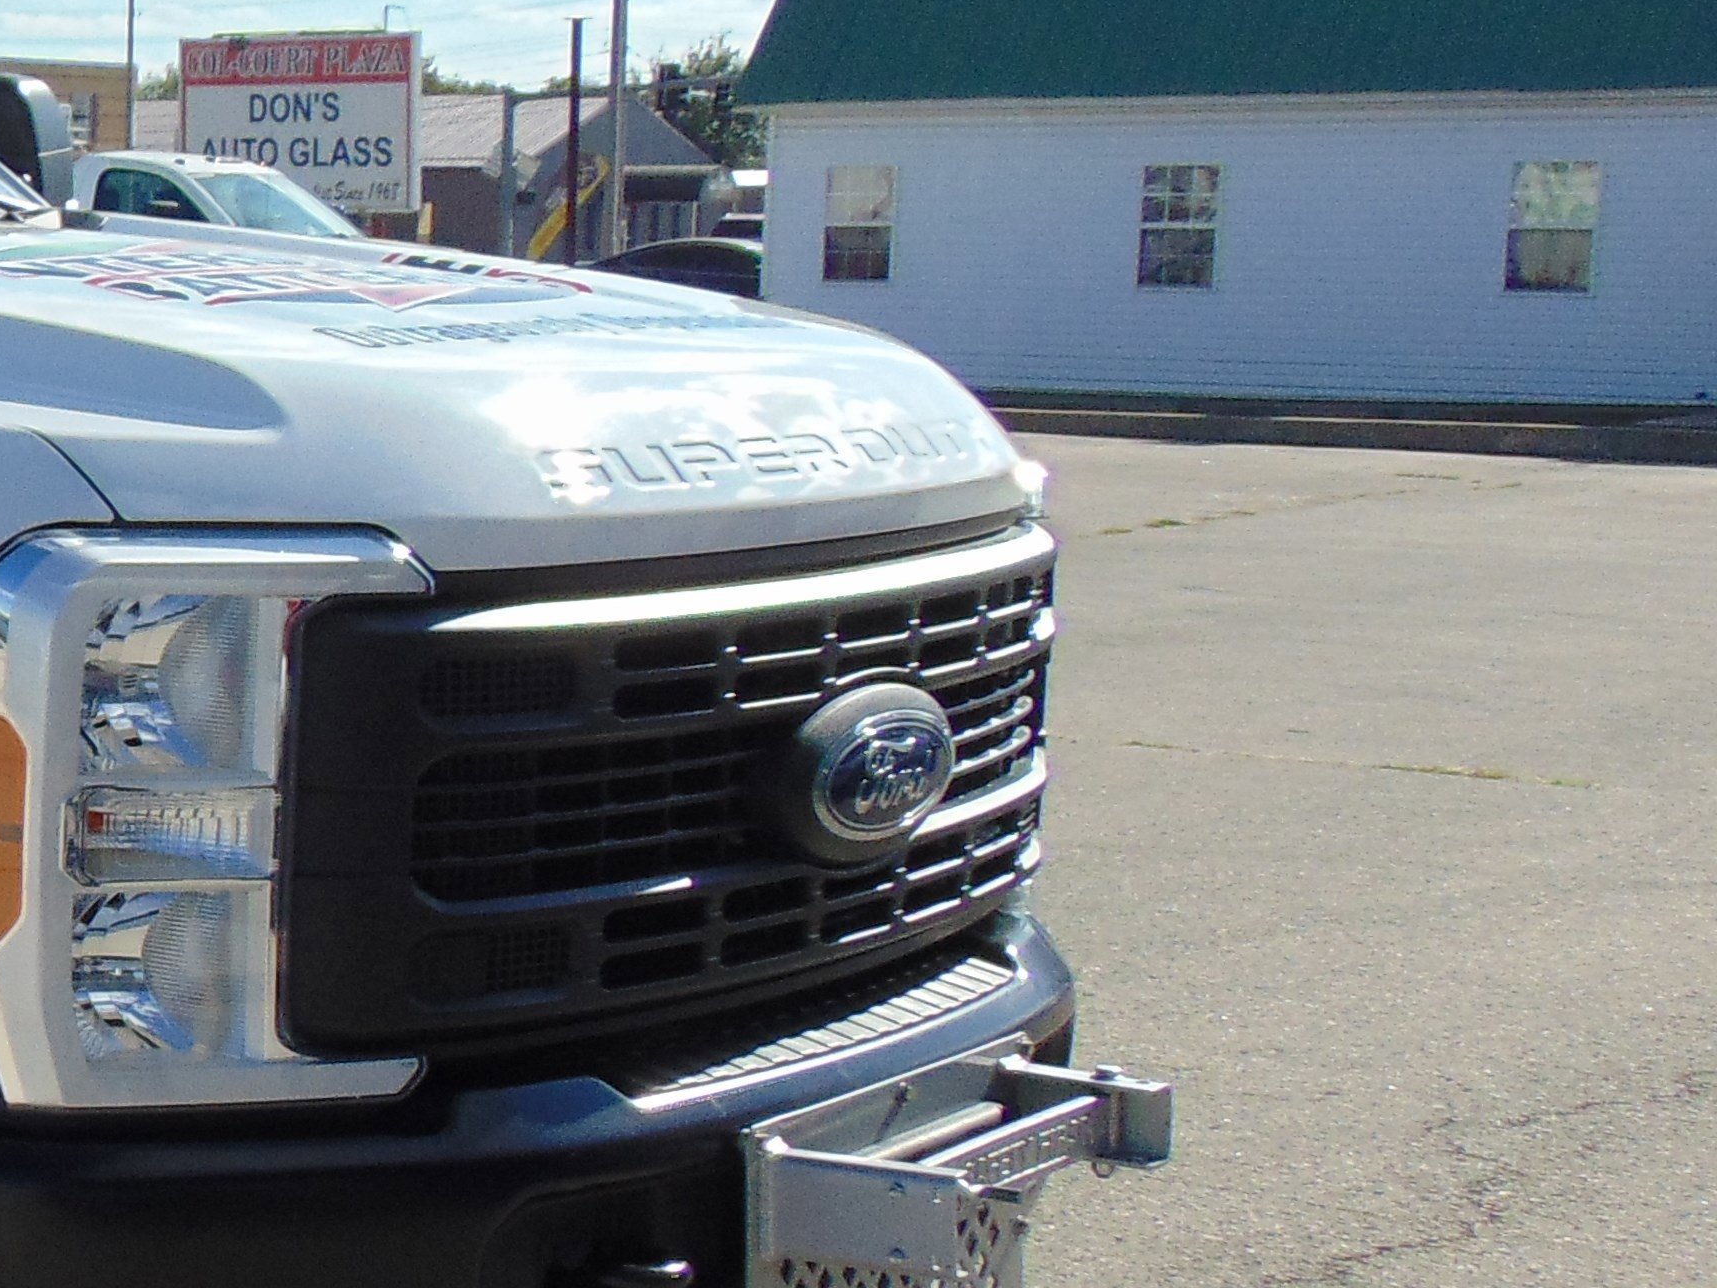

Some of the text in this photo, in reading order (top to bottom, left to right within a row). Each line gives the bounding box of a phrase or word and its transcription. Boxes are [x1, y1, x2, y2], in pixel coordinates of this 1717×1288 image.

[323, 41, 407, 75] PLAZA
[249, 91, 341, 123] DON'S
[202, 136, 394, 168] AUTO GLASS
